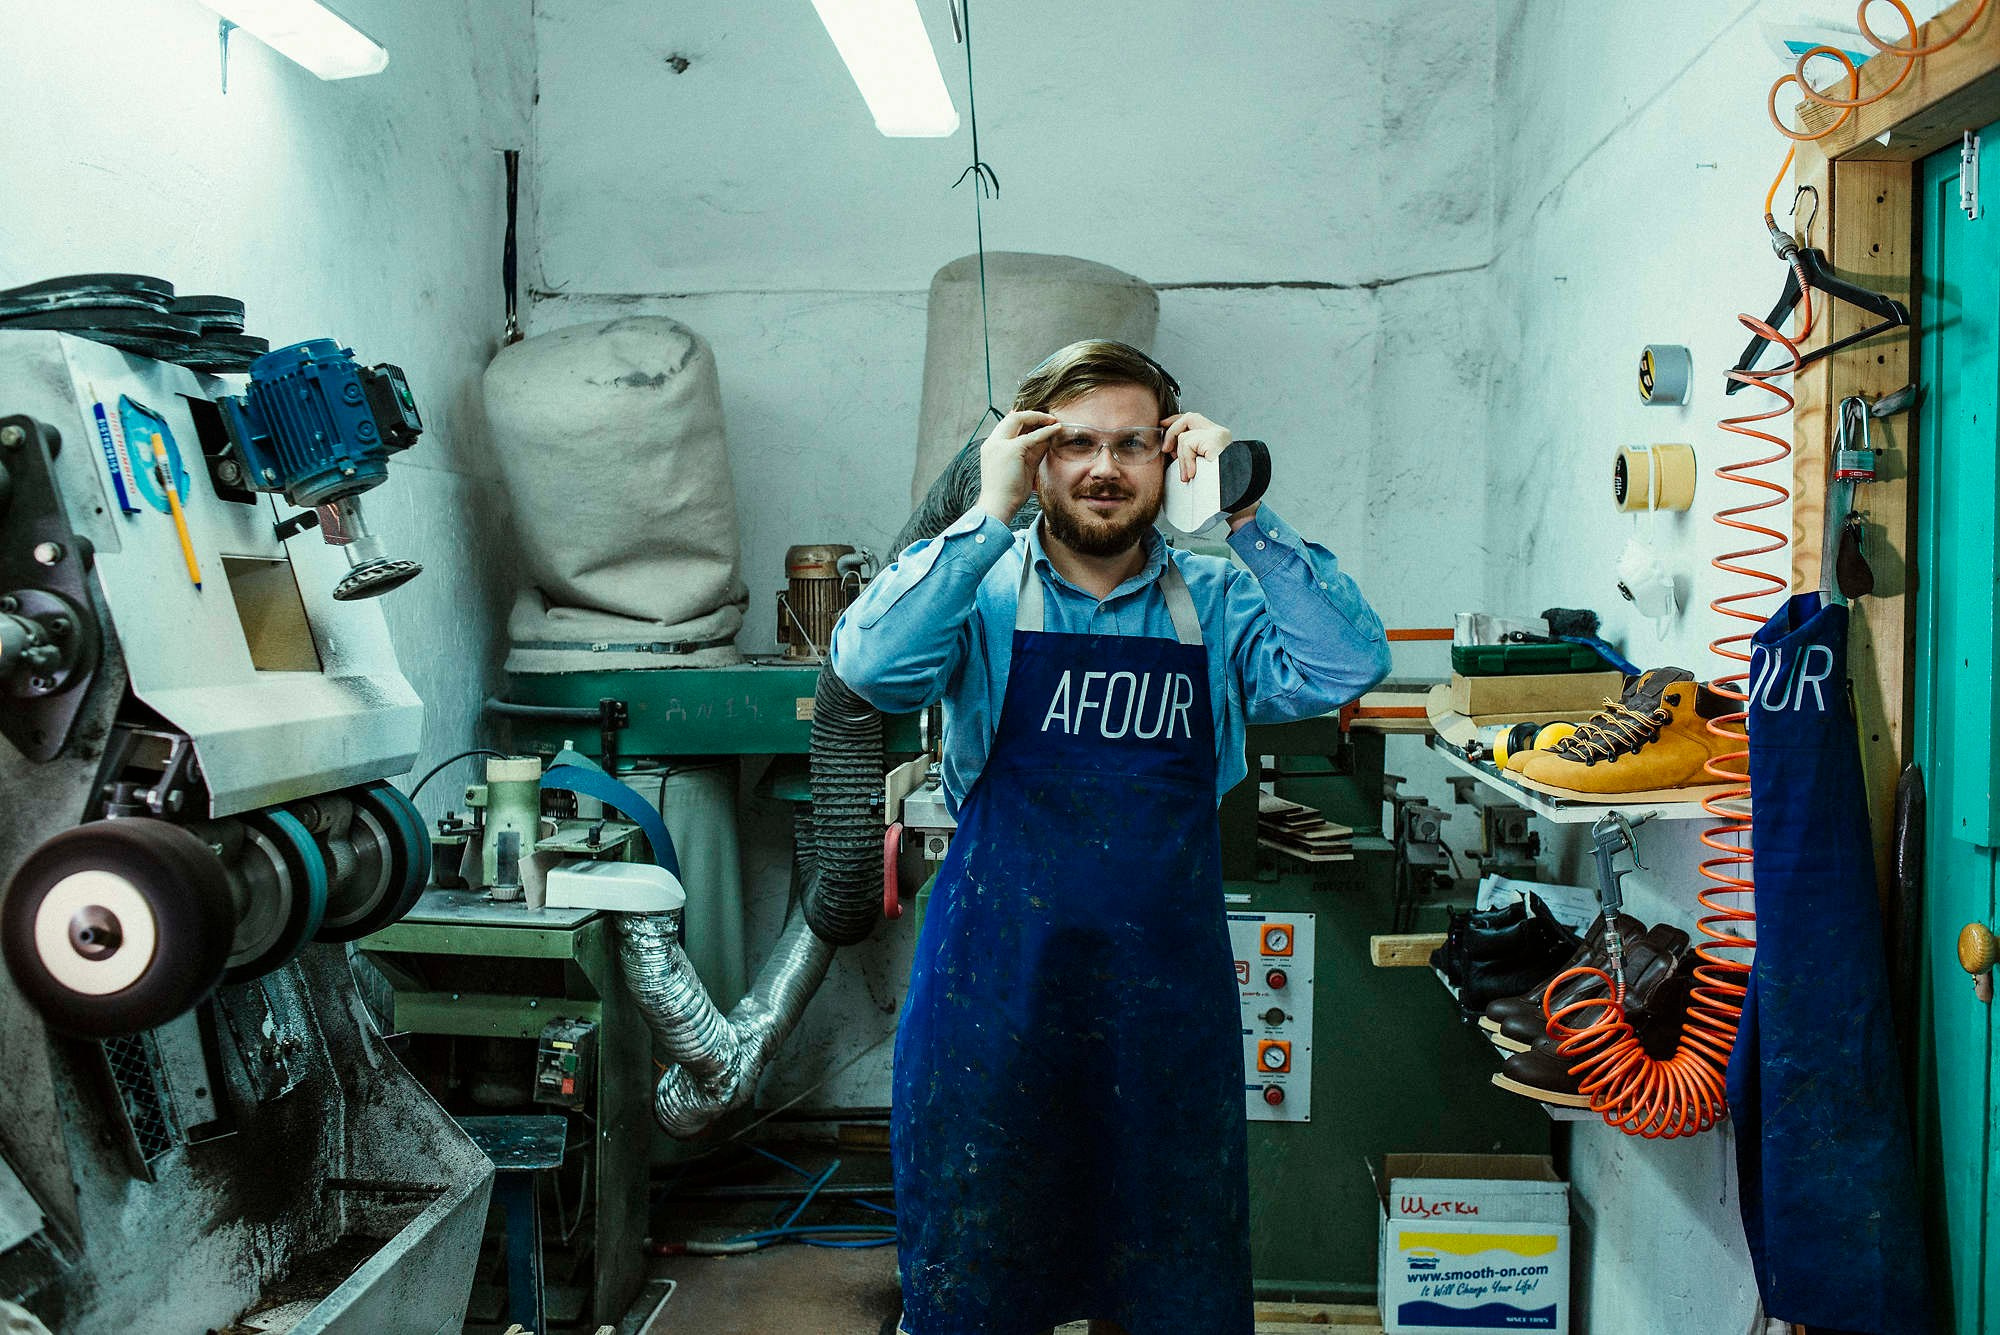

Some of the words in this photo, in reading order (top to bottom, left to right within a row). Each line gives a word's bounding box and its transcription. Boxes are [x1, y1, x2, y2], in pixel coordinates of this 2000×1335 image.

[1041, 670, 1193, 739] AFOUR
[1401, 1196, 1479, 1218] Щетки
[1407, 1265, 1549, 1283] www.smooth-on.com
[1433, 1284, 1455, 1297] Will
[1456, 1282, 1488, 1298] Change
[1492, 1280, 1512, 1293] Your
[1515, 1279, 1539, 1295] Life!
